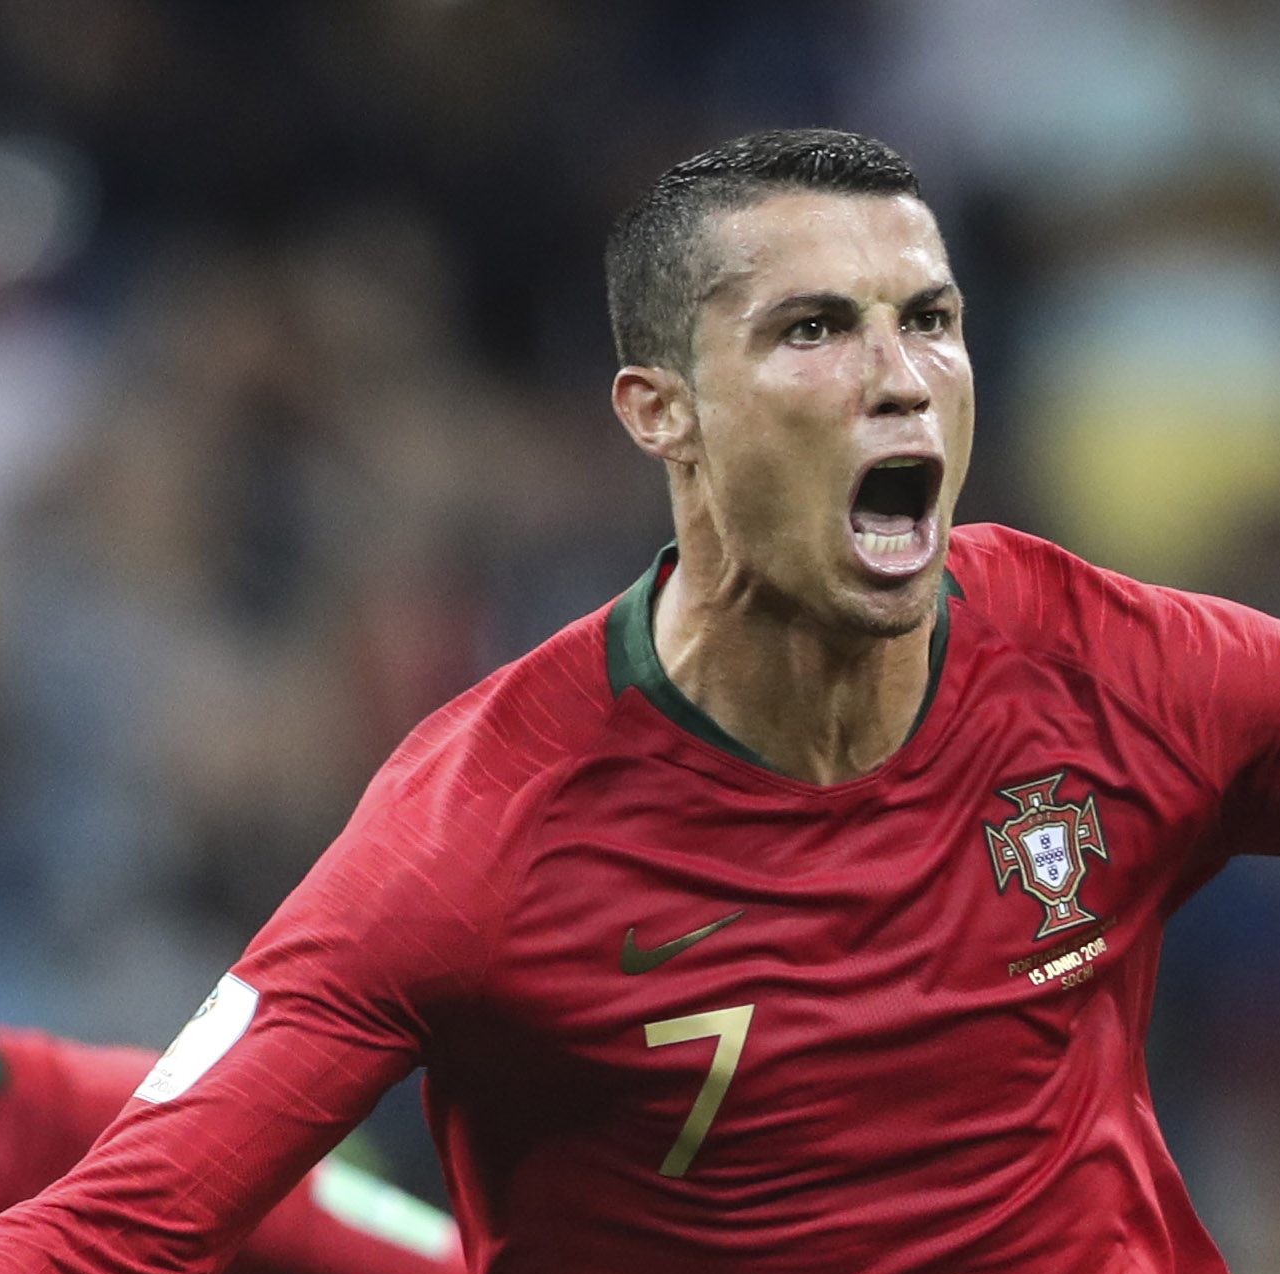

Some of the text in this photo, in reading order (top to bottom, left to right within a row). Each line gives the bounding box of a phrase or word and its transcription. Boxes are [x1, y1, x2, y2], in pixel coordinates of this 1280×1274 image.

[1028, 937, 1108, 986] 15 JUNHO 2018
[1061, 964, 1094, 990] SOCHI
[644, 1004, 755, 1178] 7
